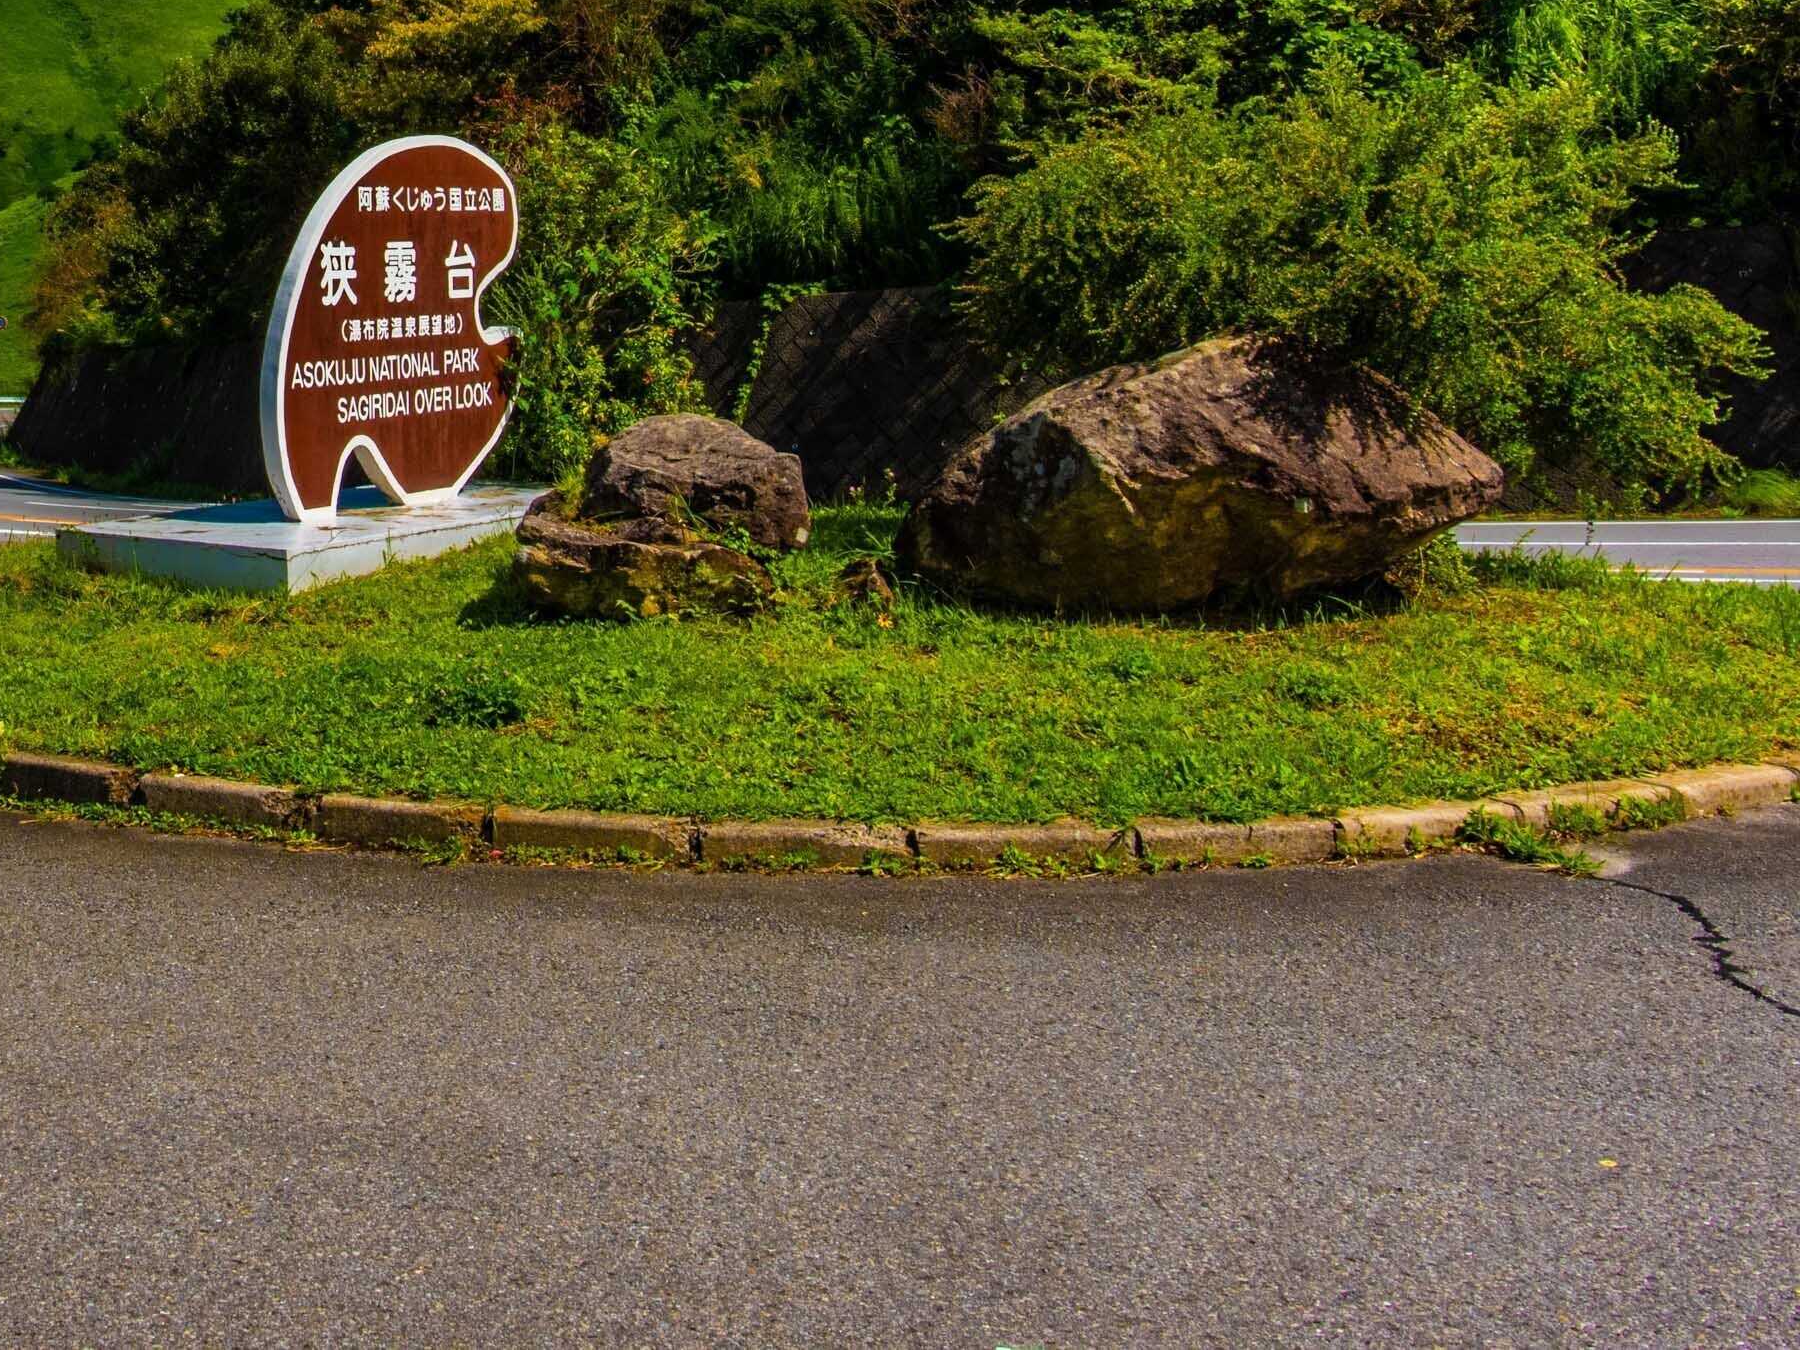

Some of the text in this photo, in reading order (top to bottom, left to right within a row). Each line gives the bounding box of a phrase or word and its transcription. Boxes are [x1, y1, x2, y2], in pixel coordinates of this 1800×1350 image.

[358, 185, 505, 212] 阿蘇くじゅう国立公園
[320, 240, 476, 306] 狭霧台
[291, 347, 480, 390] ASOKUJU NATIONAL PARK
[337, 381, 493, 423] SAGIRIDAI OVER LOOK
